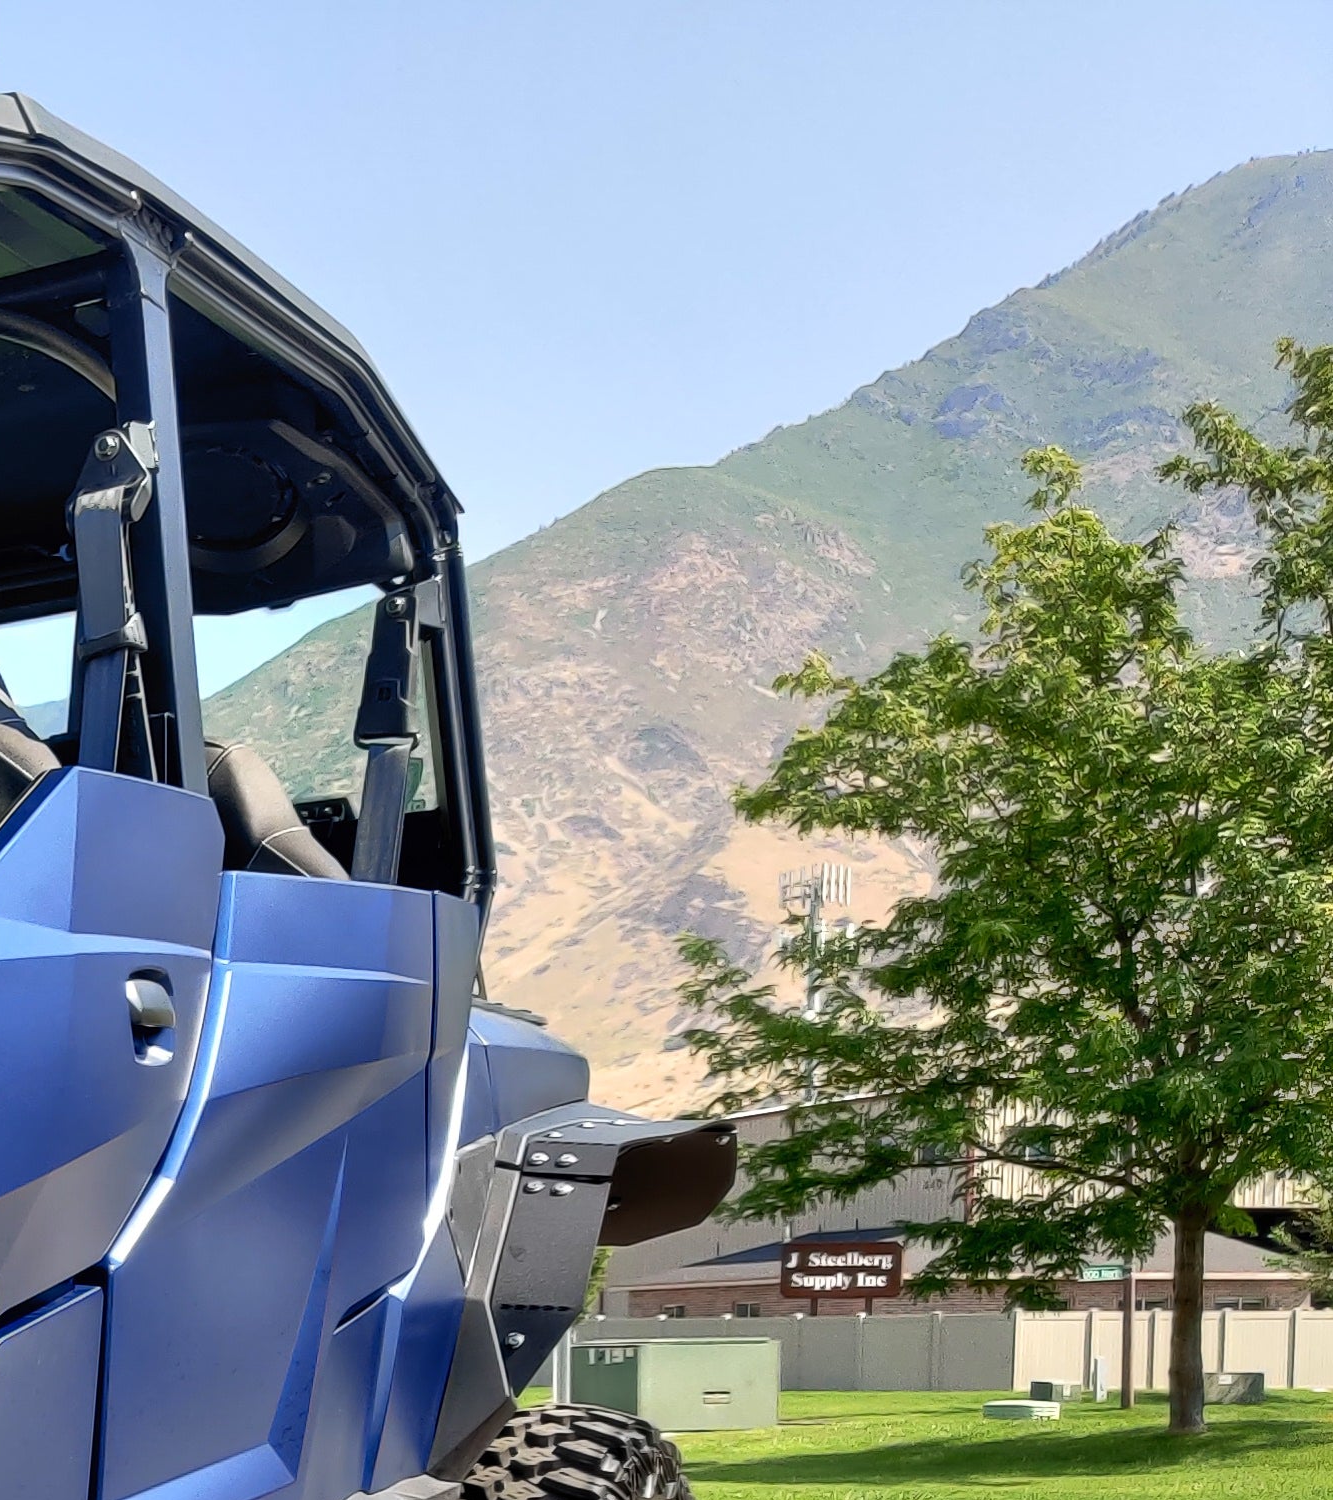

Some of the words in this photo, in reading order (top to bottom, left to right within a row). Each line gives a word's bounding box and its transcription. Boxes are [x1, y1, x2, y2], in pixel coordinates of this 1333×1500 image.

[785, 1252, 800, 1269] J
[808, 1251, 893, 1270] Steelberg
[790, 1271, 853, 1291] Supply
[856, 1272, 888, 1288] Inc
